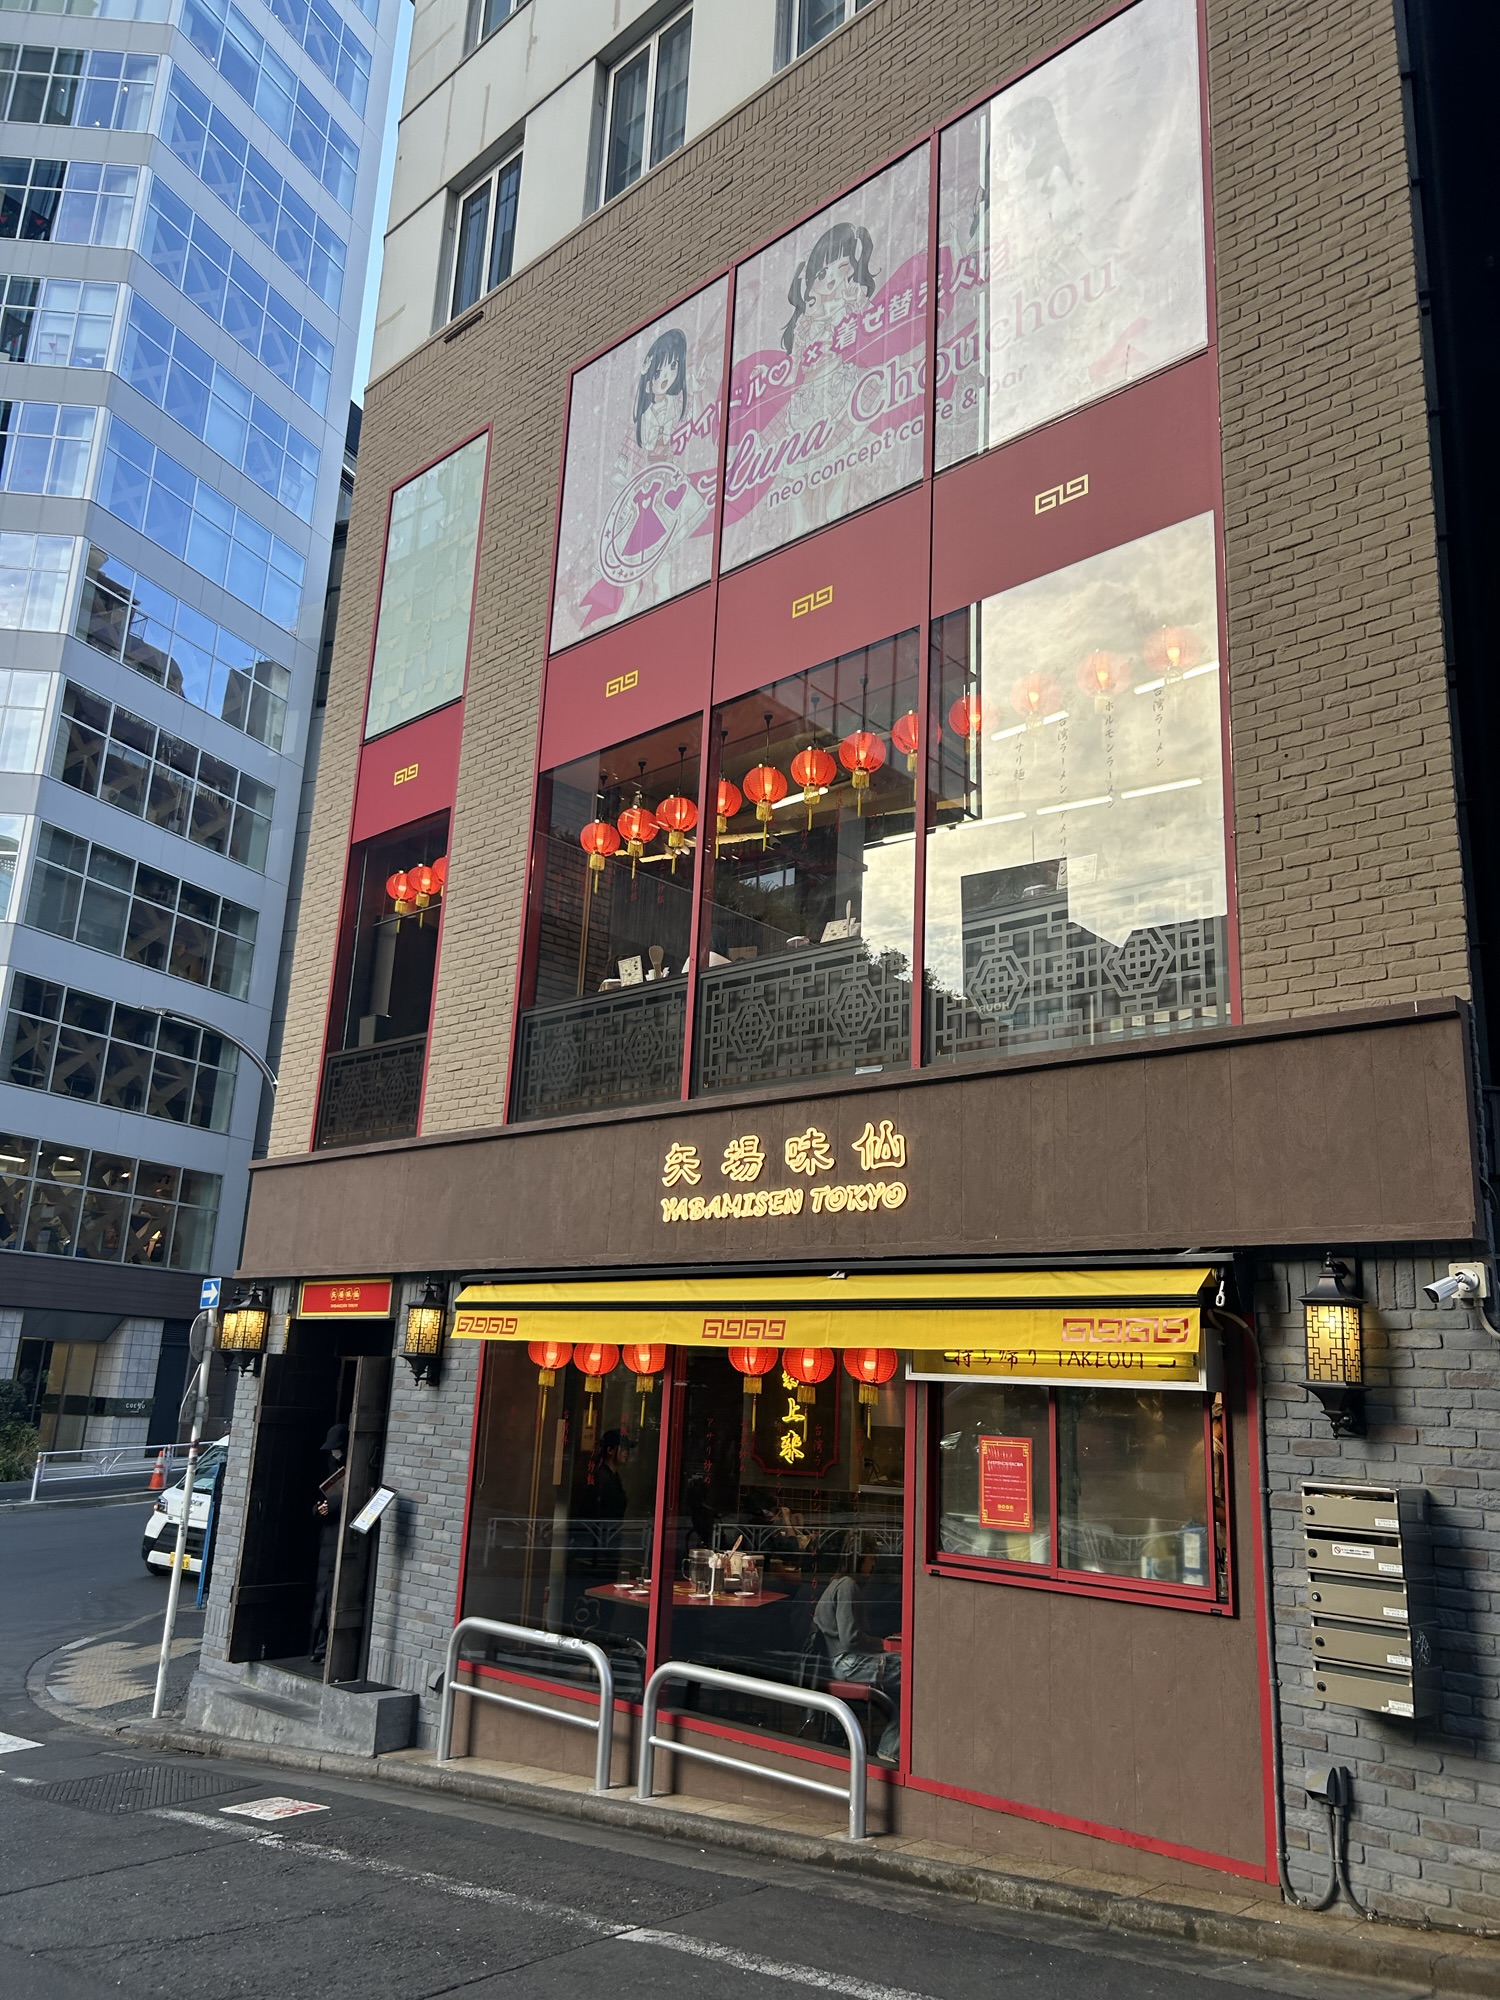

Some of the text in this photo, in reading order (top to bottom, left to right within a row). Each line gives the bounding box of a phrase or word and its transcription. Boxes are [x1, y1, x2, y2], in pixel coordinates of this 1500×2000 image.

[700, 418, 834, 506] Luna
[769, 480, 804, 508] neo
[810, 431, 892, 488] concept
[899, 399, 954, 439] cafe
[963, 386, 979, 410] &
[1104, 700, 1115, 809] ホルモンラーメン
[1152, 687, 1165, 768] 台湾ラーメン
[660, 1181, 907, 1223] YABAMISEN TOKYO
[1056, 1350, 1145, 1370] TAKEOUT
